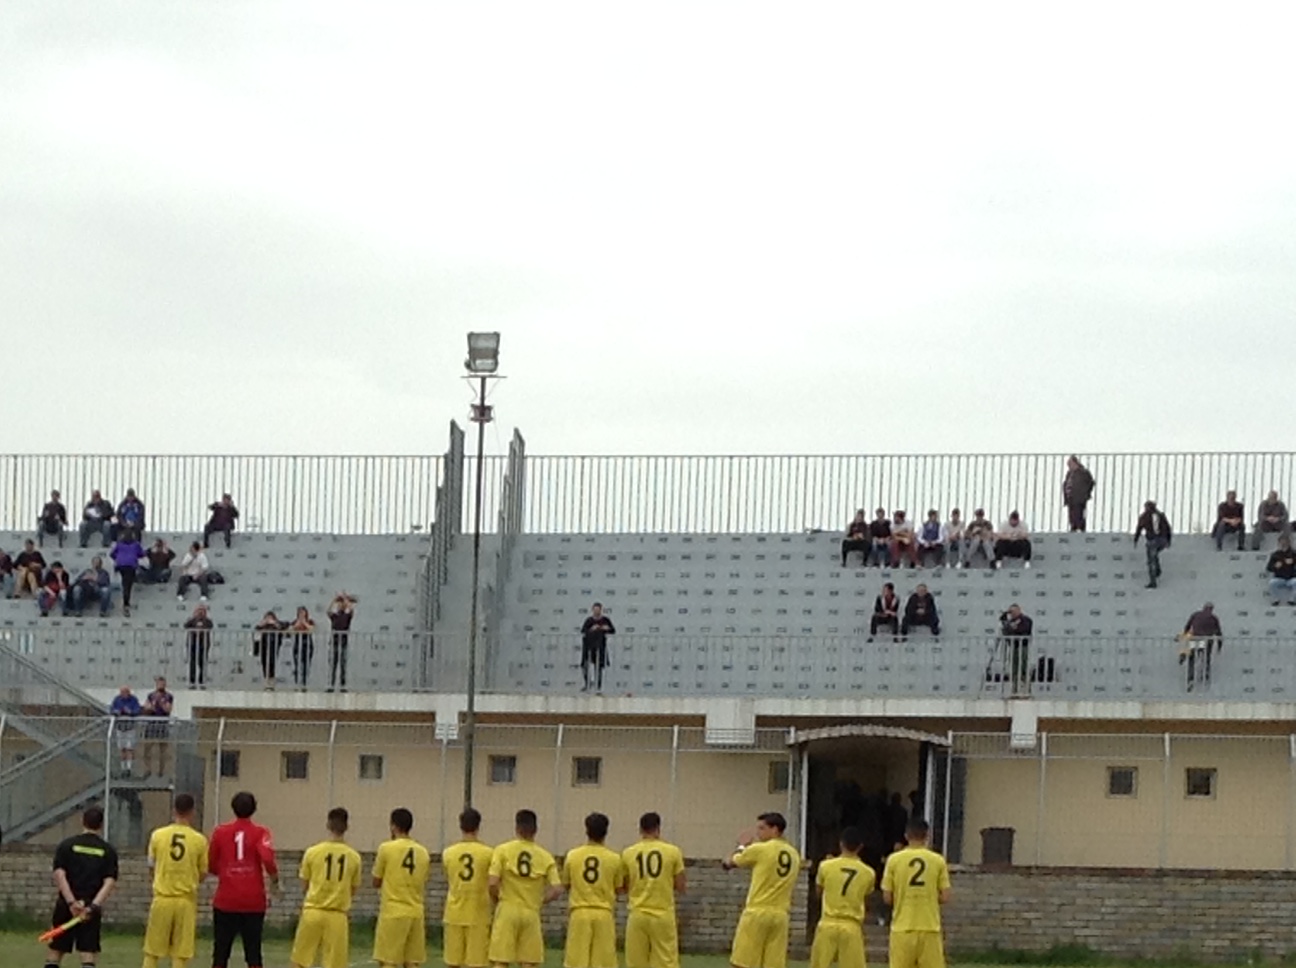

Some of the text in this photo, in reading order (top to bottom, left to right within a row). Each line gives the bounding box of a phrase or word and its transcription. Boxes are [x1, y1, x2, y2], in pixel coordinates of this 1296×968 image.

[169, 833, 186, 862] 5
[235, 831, 244, 861] 1
[324, 853, 345, 882] 11
[401, 847, 415, 876] 4
[458, 853, 474, 881] 3
[517, 851, 532, 877] 6
[583, 856, 599, 884] 8
[635, 850, 662, 880] 10
[777, 850, 792, 878] 9
[908, 857, 926, 886] 2
[840, 867, 858, 896] 7
